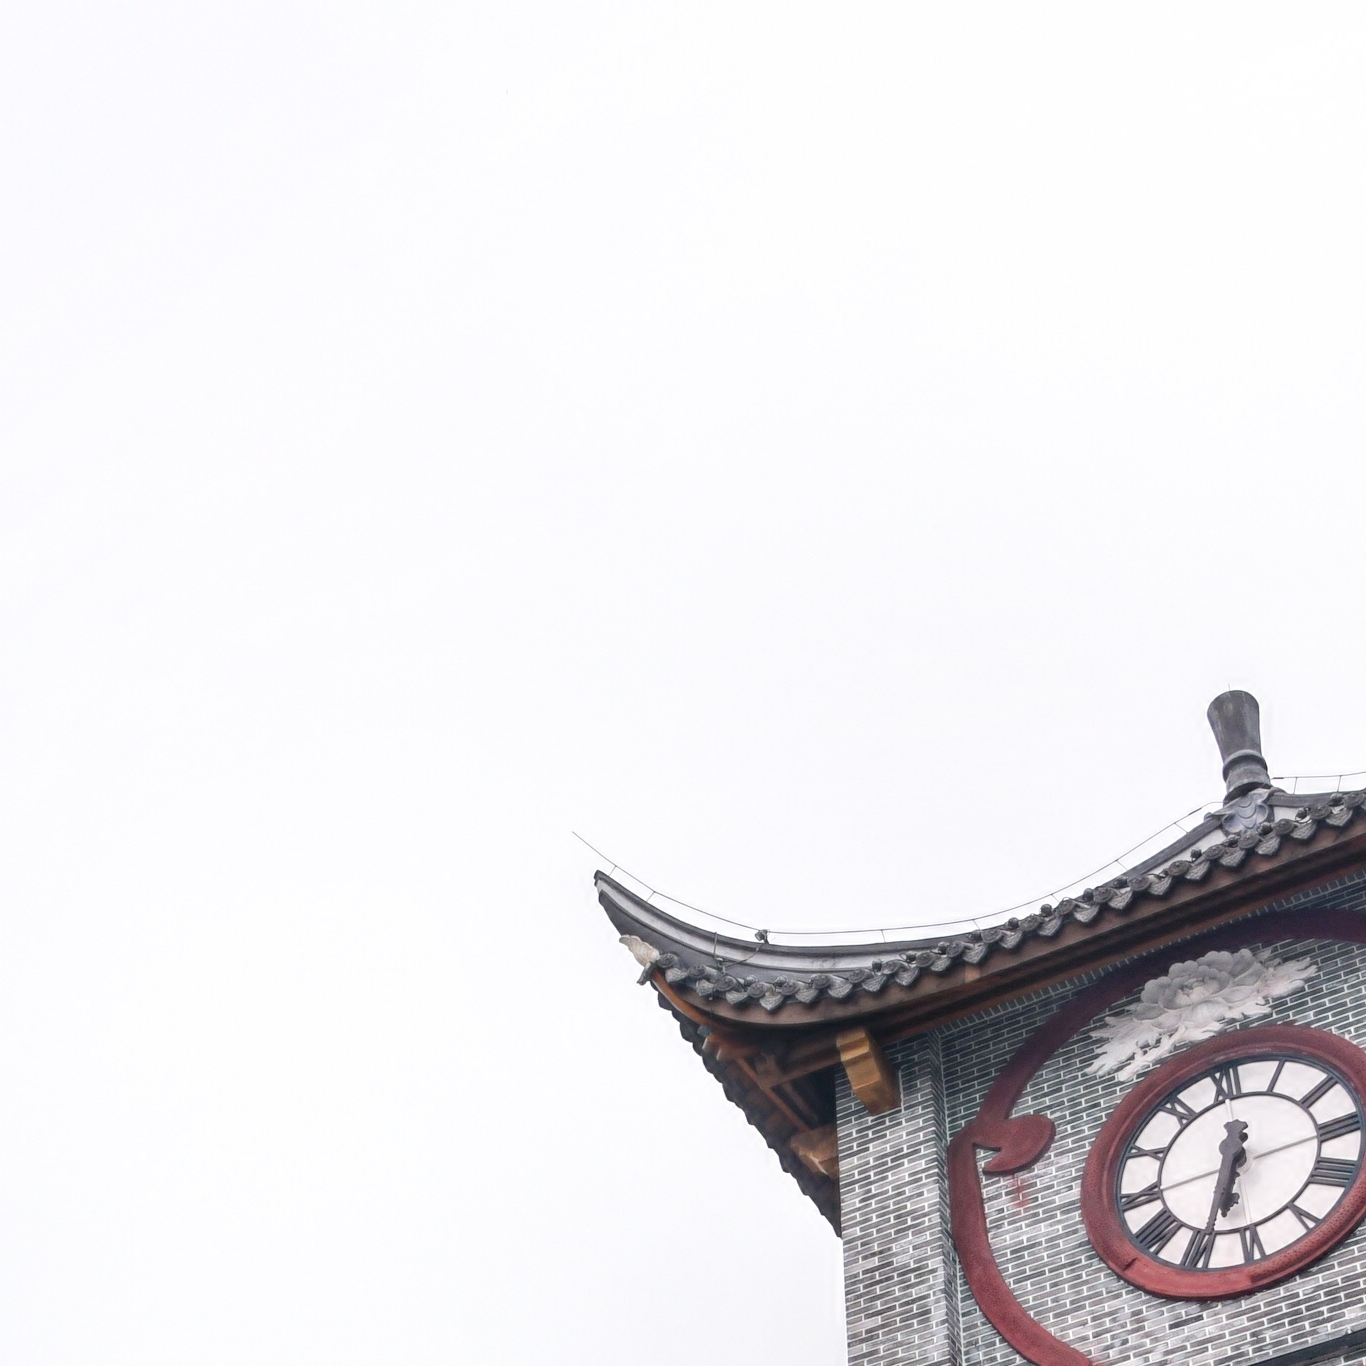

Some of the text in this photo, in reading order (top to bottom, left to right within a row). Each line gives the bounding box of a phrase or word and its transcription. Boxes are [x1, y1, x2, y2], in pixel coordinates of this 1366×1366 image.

[1209, 1064, 1242, 1102] XII
[1298, 1073, 1340, 1110] II
[1157, 1096, 1197, 1127] XI
[1316, 1111, 1361, 1143] III
[1126, 1144, 1168, 1161] X
[1308, 1157, 1358, 1188] IIII
[1119, 1181, 1161, 1213] IX
[1288, 1203, 1323, 1232] V
[1239, 1224, 1268, 1263] VI
